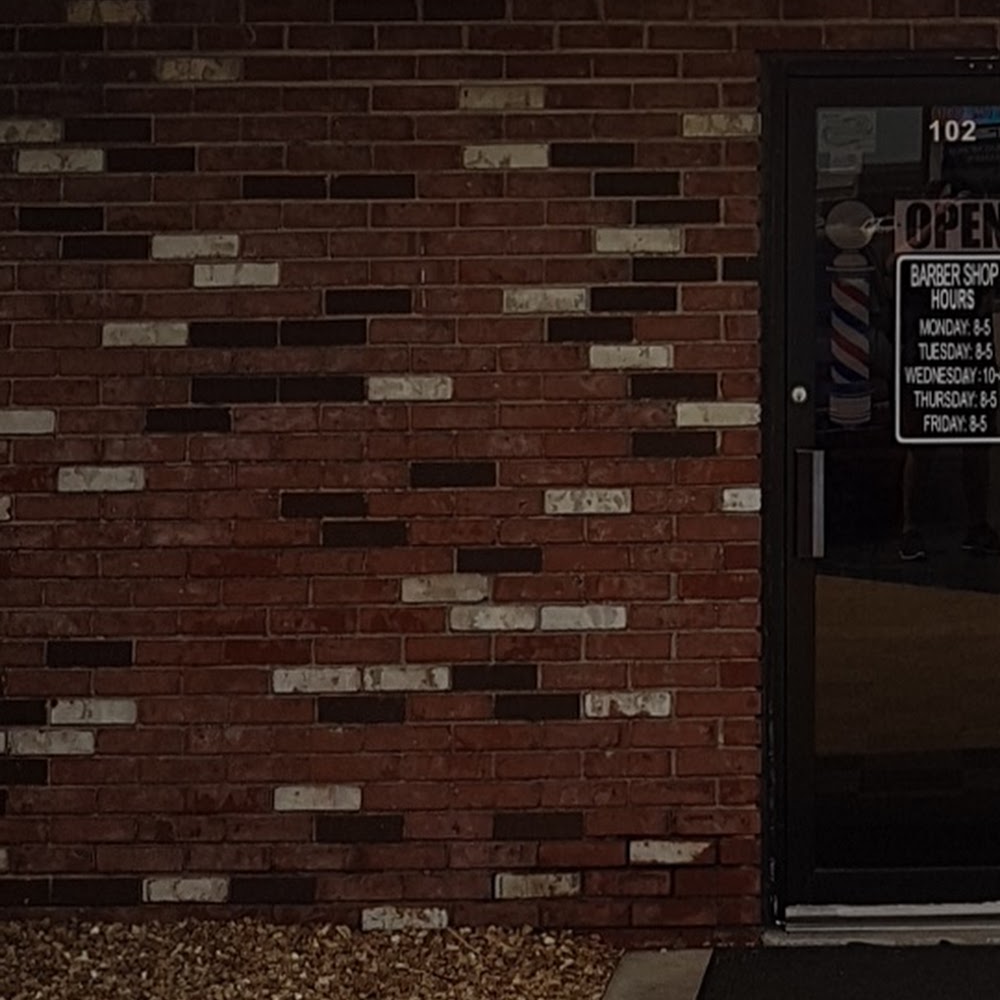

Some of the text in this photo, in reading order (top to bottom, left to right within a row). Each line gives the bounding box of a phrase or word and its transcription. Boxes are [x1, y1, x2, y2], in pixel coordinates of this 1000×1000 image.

[929, 120, 977, 142] 102
[910, 262, 1000, 288] BARBER SHOP
[930, 288, 976, 311] HOURS
[919, 318, 992, 337] MONDAY: 8-5
[917, 342, 994, 361] TUESDAY: 8-5
[913, 390, 998, 409] THURSDAY: 8-5
[923, 414, 988, 433] FRIDAY: 8-5
